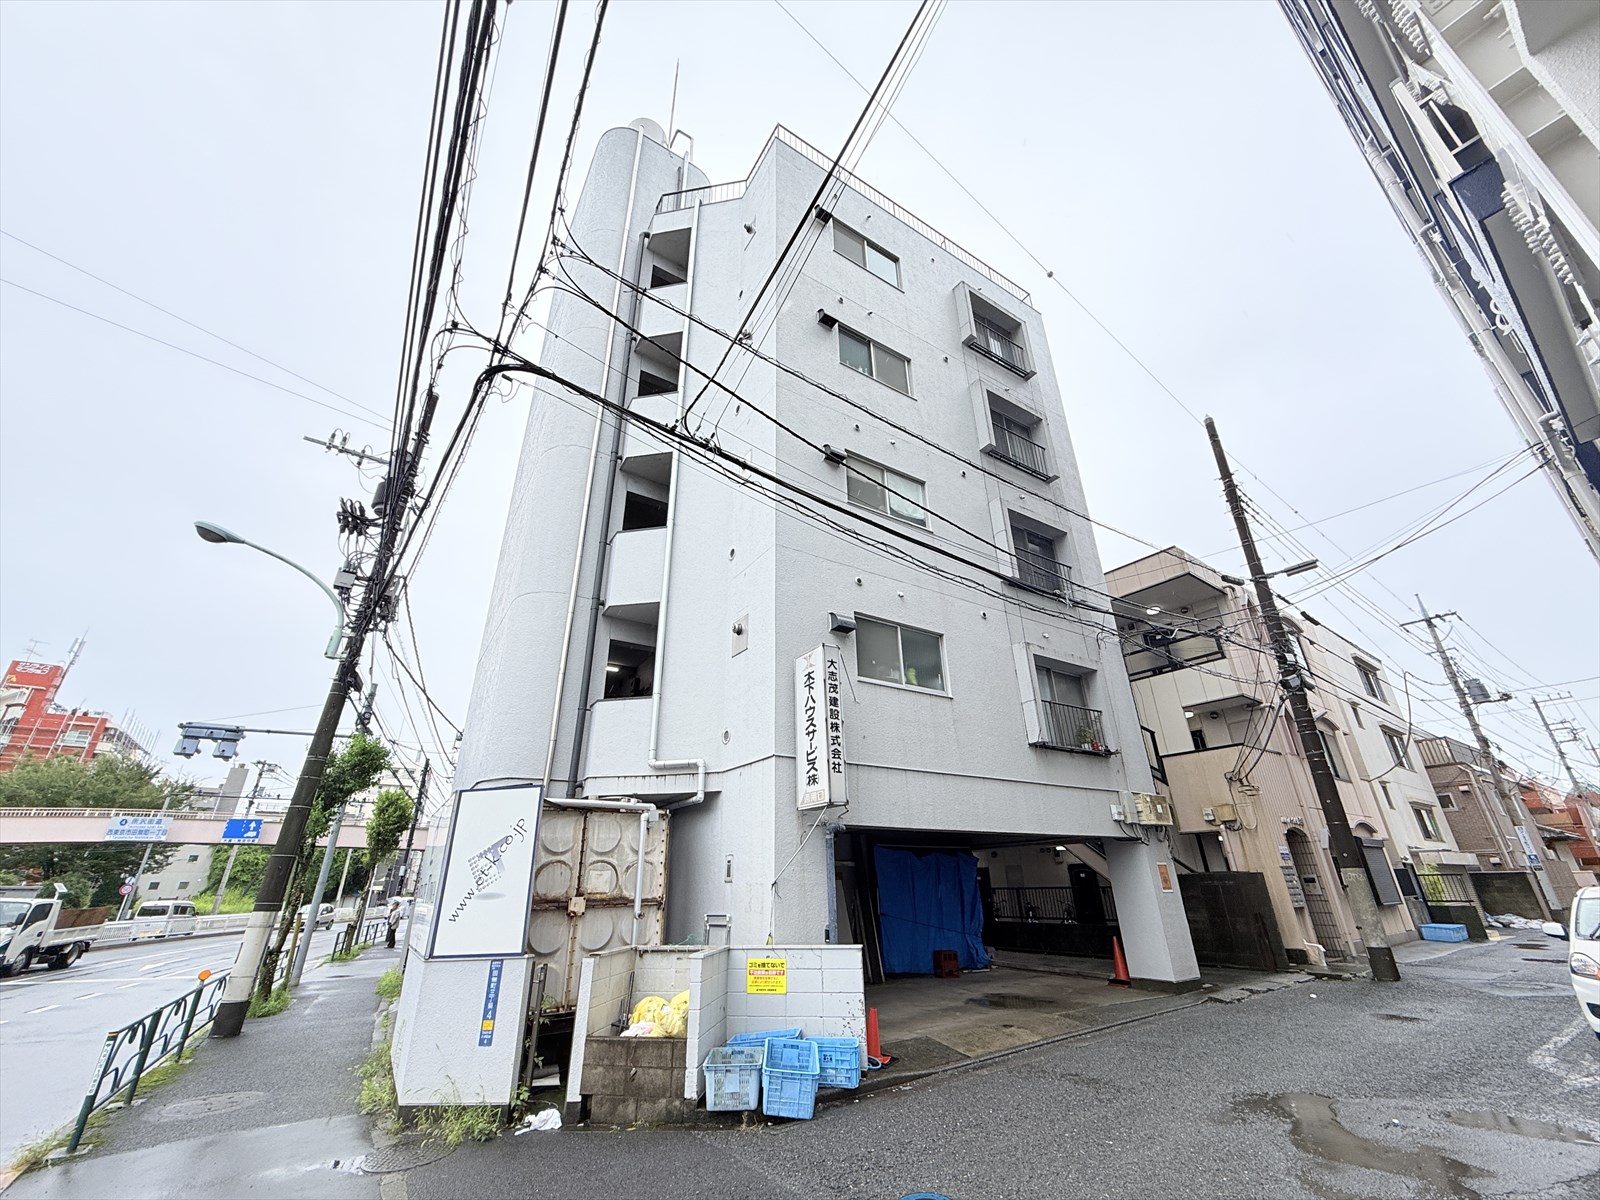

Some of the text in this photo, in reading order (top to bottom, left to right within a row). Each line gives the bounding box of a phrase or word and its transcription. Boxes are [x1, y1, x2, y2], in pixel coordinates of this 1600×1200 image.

[827, 659, 843, 774] 大志茂建設株式会社
